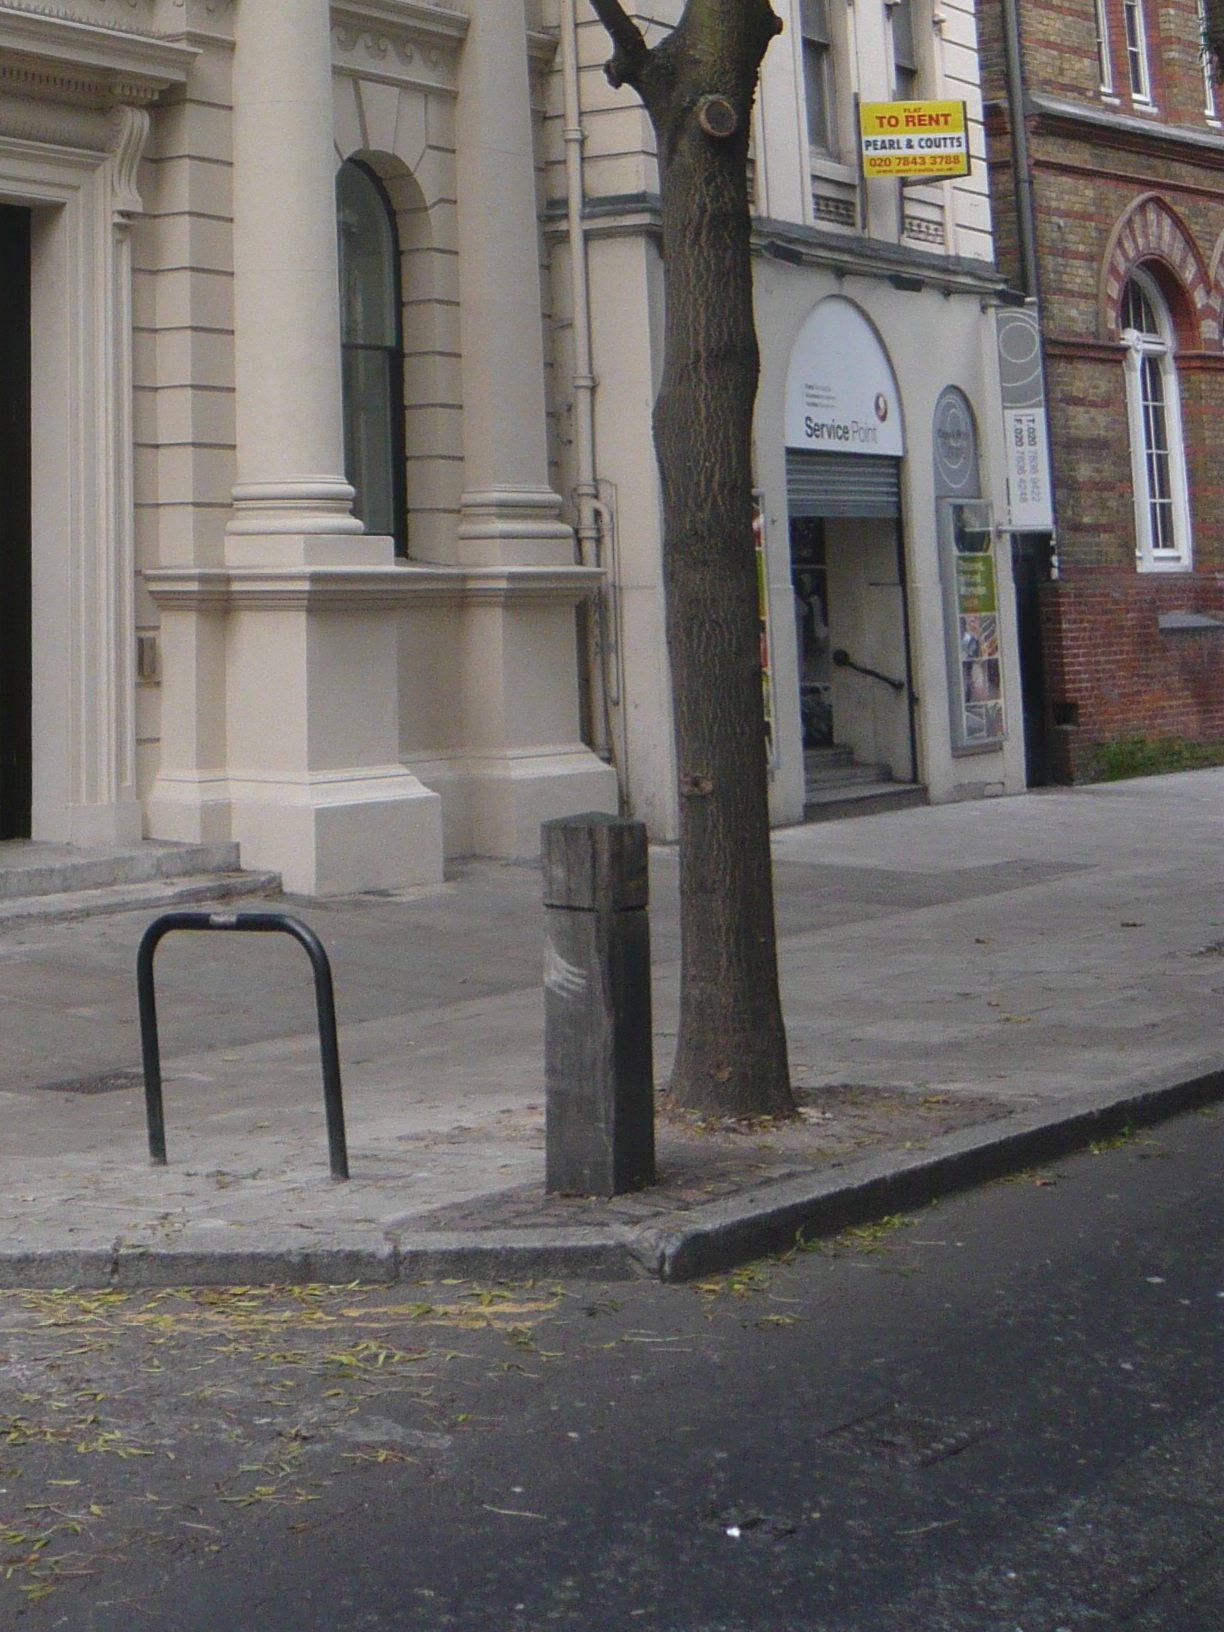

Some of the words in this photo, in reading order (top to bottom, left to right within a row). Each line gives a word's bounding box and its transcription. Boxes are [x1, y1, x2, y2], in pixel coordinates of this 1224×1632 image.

[875, 115, 899, 128] TO
[904, 113, 952, 127] RENT
[864, 138, 903, 151] PEARL
[905, 138, 914, 149] &
[918, 136, 962, 148] COUTTS
[869, 157, 891, 167] 020
[895, 156, 926, 166] 7843
[930, 155, 960, 165] 3788
[804, 415, 849, 441] Service
[851, 420, 878, 444] Point
